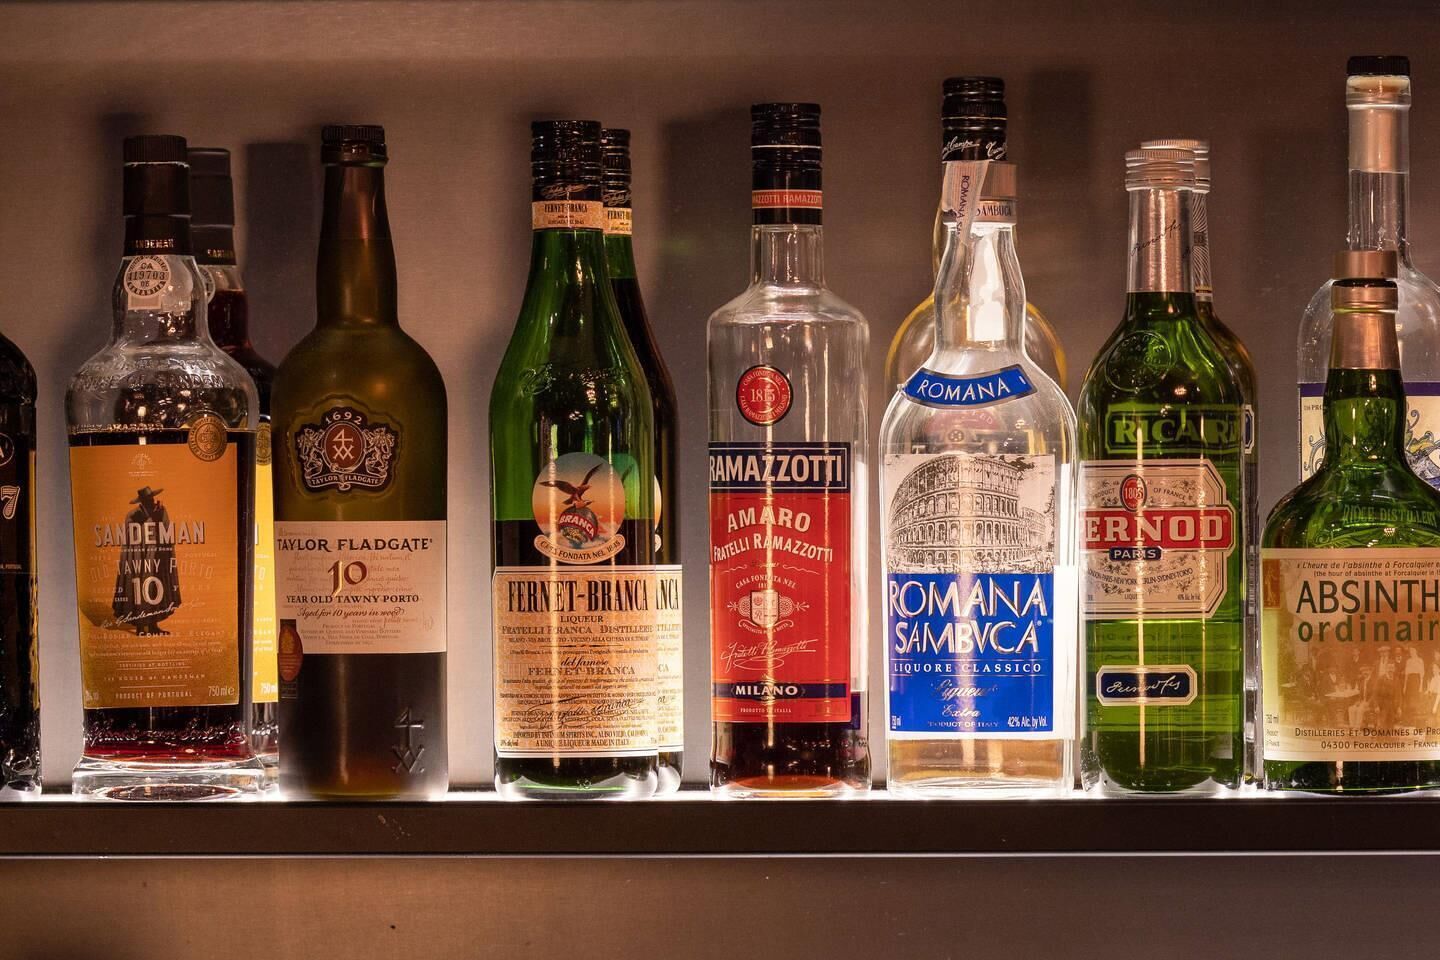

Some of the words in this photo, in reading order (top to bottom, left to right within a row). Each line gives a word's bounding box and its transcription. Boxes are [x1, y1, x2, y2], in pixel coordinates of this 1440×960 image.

[956, 175, 970, 219] ROMANA
[917, 373, 1010, 401] ROMANA
[325, 411, 362, 426] 1692
[312, 474, 339, 486] TAYLOR
[344, 474, 380, 486] FLADGATE
[709, 454, 843, 483] RAMAZZOTTI
[559, 514, 595, 537] BRANCA
[727, 505, 811, 533] AMARO
[1086, 515, 1224, 542] ERNOD
[94, 520, 206, 547] SANDEMAN
[277, 538, 332, 552] TAYLOR
[337, 538, 429, 552] FLADGATE
[713, 536, 750, 562] FRATELLI
[753, 532, 833, 563] RAMAZZOTTI
[1114, 550, 1156, 559] PARIS
[116, 558, 161, 574] TAWNY
[328, 559, 368, 597] 10
[131, 575, 164, 606] 10
[286, 595, 309, 604] YEAR
[310, 595, 333, 604] OLD
[336, 595, 381, 603] TAWNY
[383, 594, 420, 603] PORTO
[508, 578, 649, 613] FERNET-BRANCA
[889, 575, 1048, 618] ROMANA
[560, 614, 604, 624] LIQUEUR
[893, 663, 952, 674] LIQUORE
[961, 663, 1042, 674] CLASSICO
[735, 684, 799, 696] MILANO
[1295, 728, 1345, 737] DISTILLERIES
[1349, 728, 1359, 737] ET
[1363, 727, 1410, 737] DOMAINES
[1413, 727, 1423, 736] DE
[1321, 740, 1350, 749] 04300
[1353, 740, 1406, 750] FORCALQUIER
